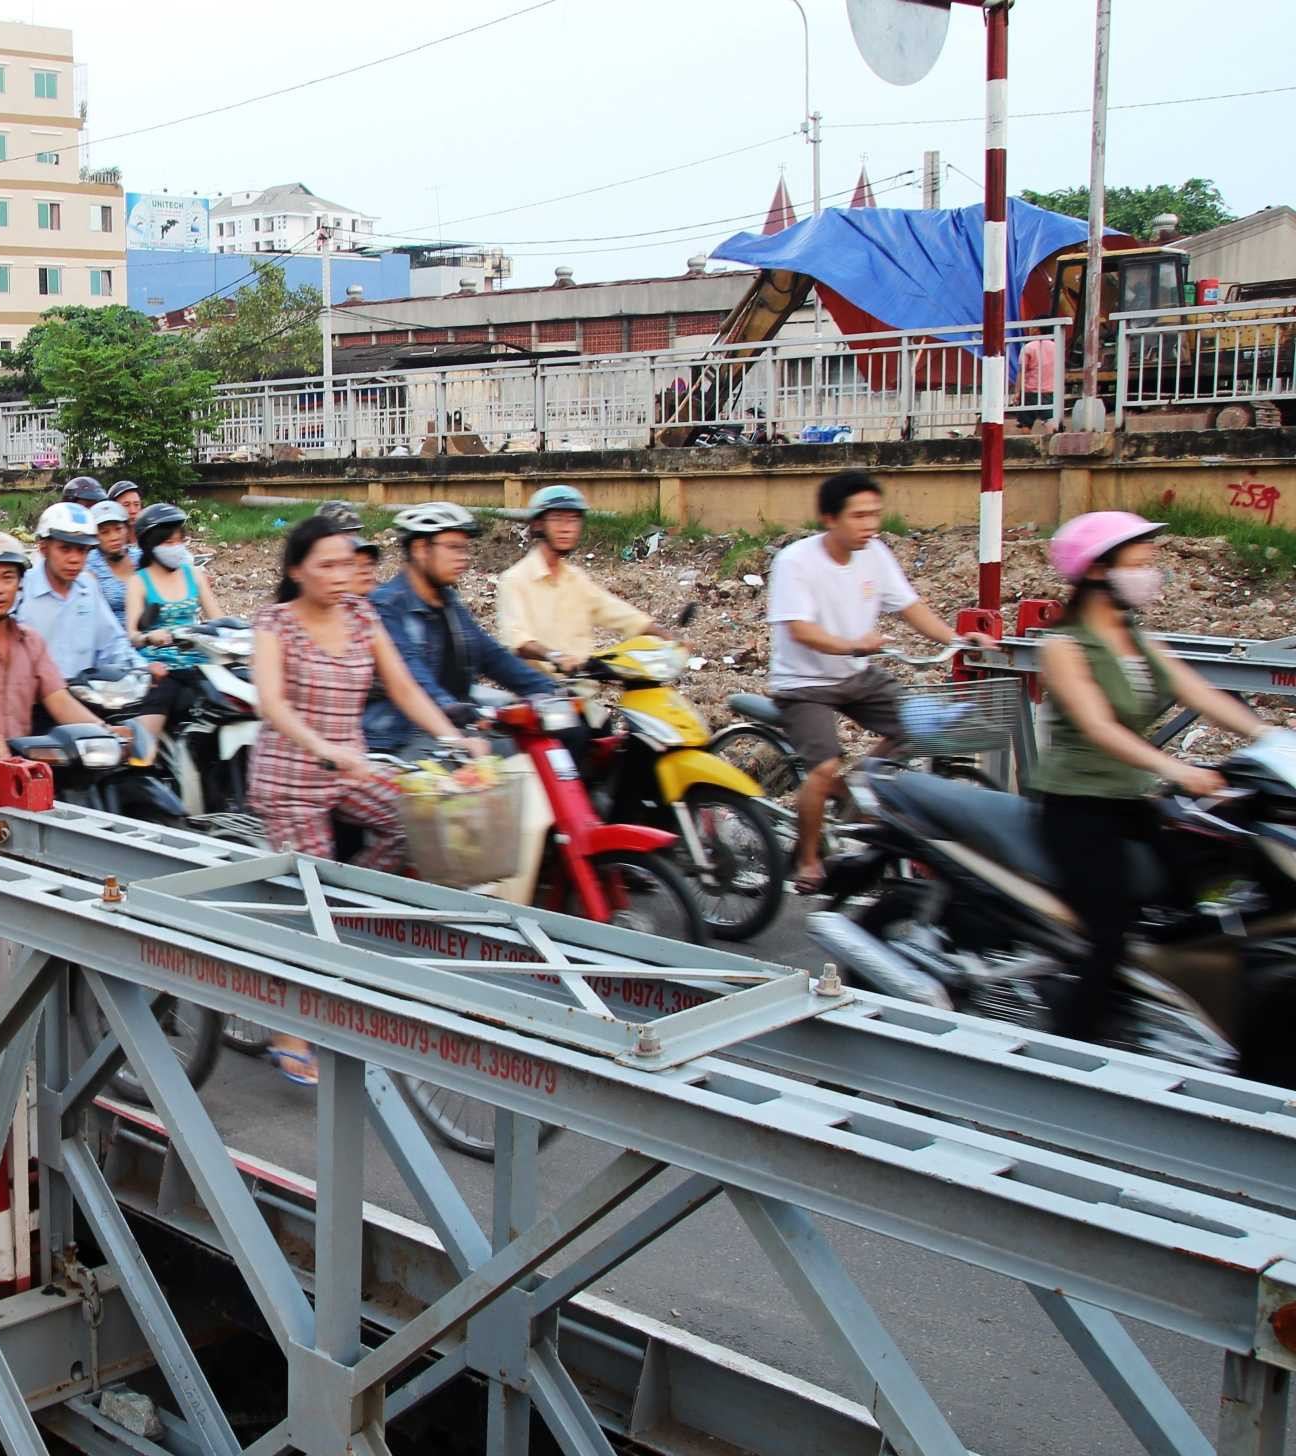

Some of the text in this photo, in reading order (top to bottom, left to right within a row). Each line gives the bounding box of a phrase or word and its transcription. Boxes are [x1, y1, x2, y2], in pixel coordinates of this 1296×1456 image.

[152, 200, 184, 209] UNITECH
[332, 915, 406, 944] NHTUNG
[411, 923, 469, 959] BAILEY
[231, 965, 288, 1009] BAILEY
